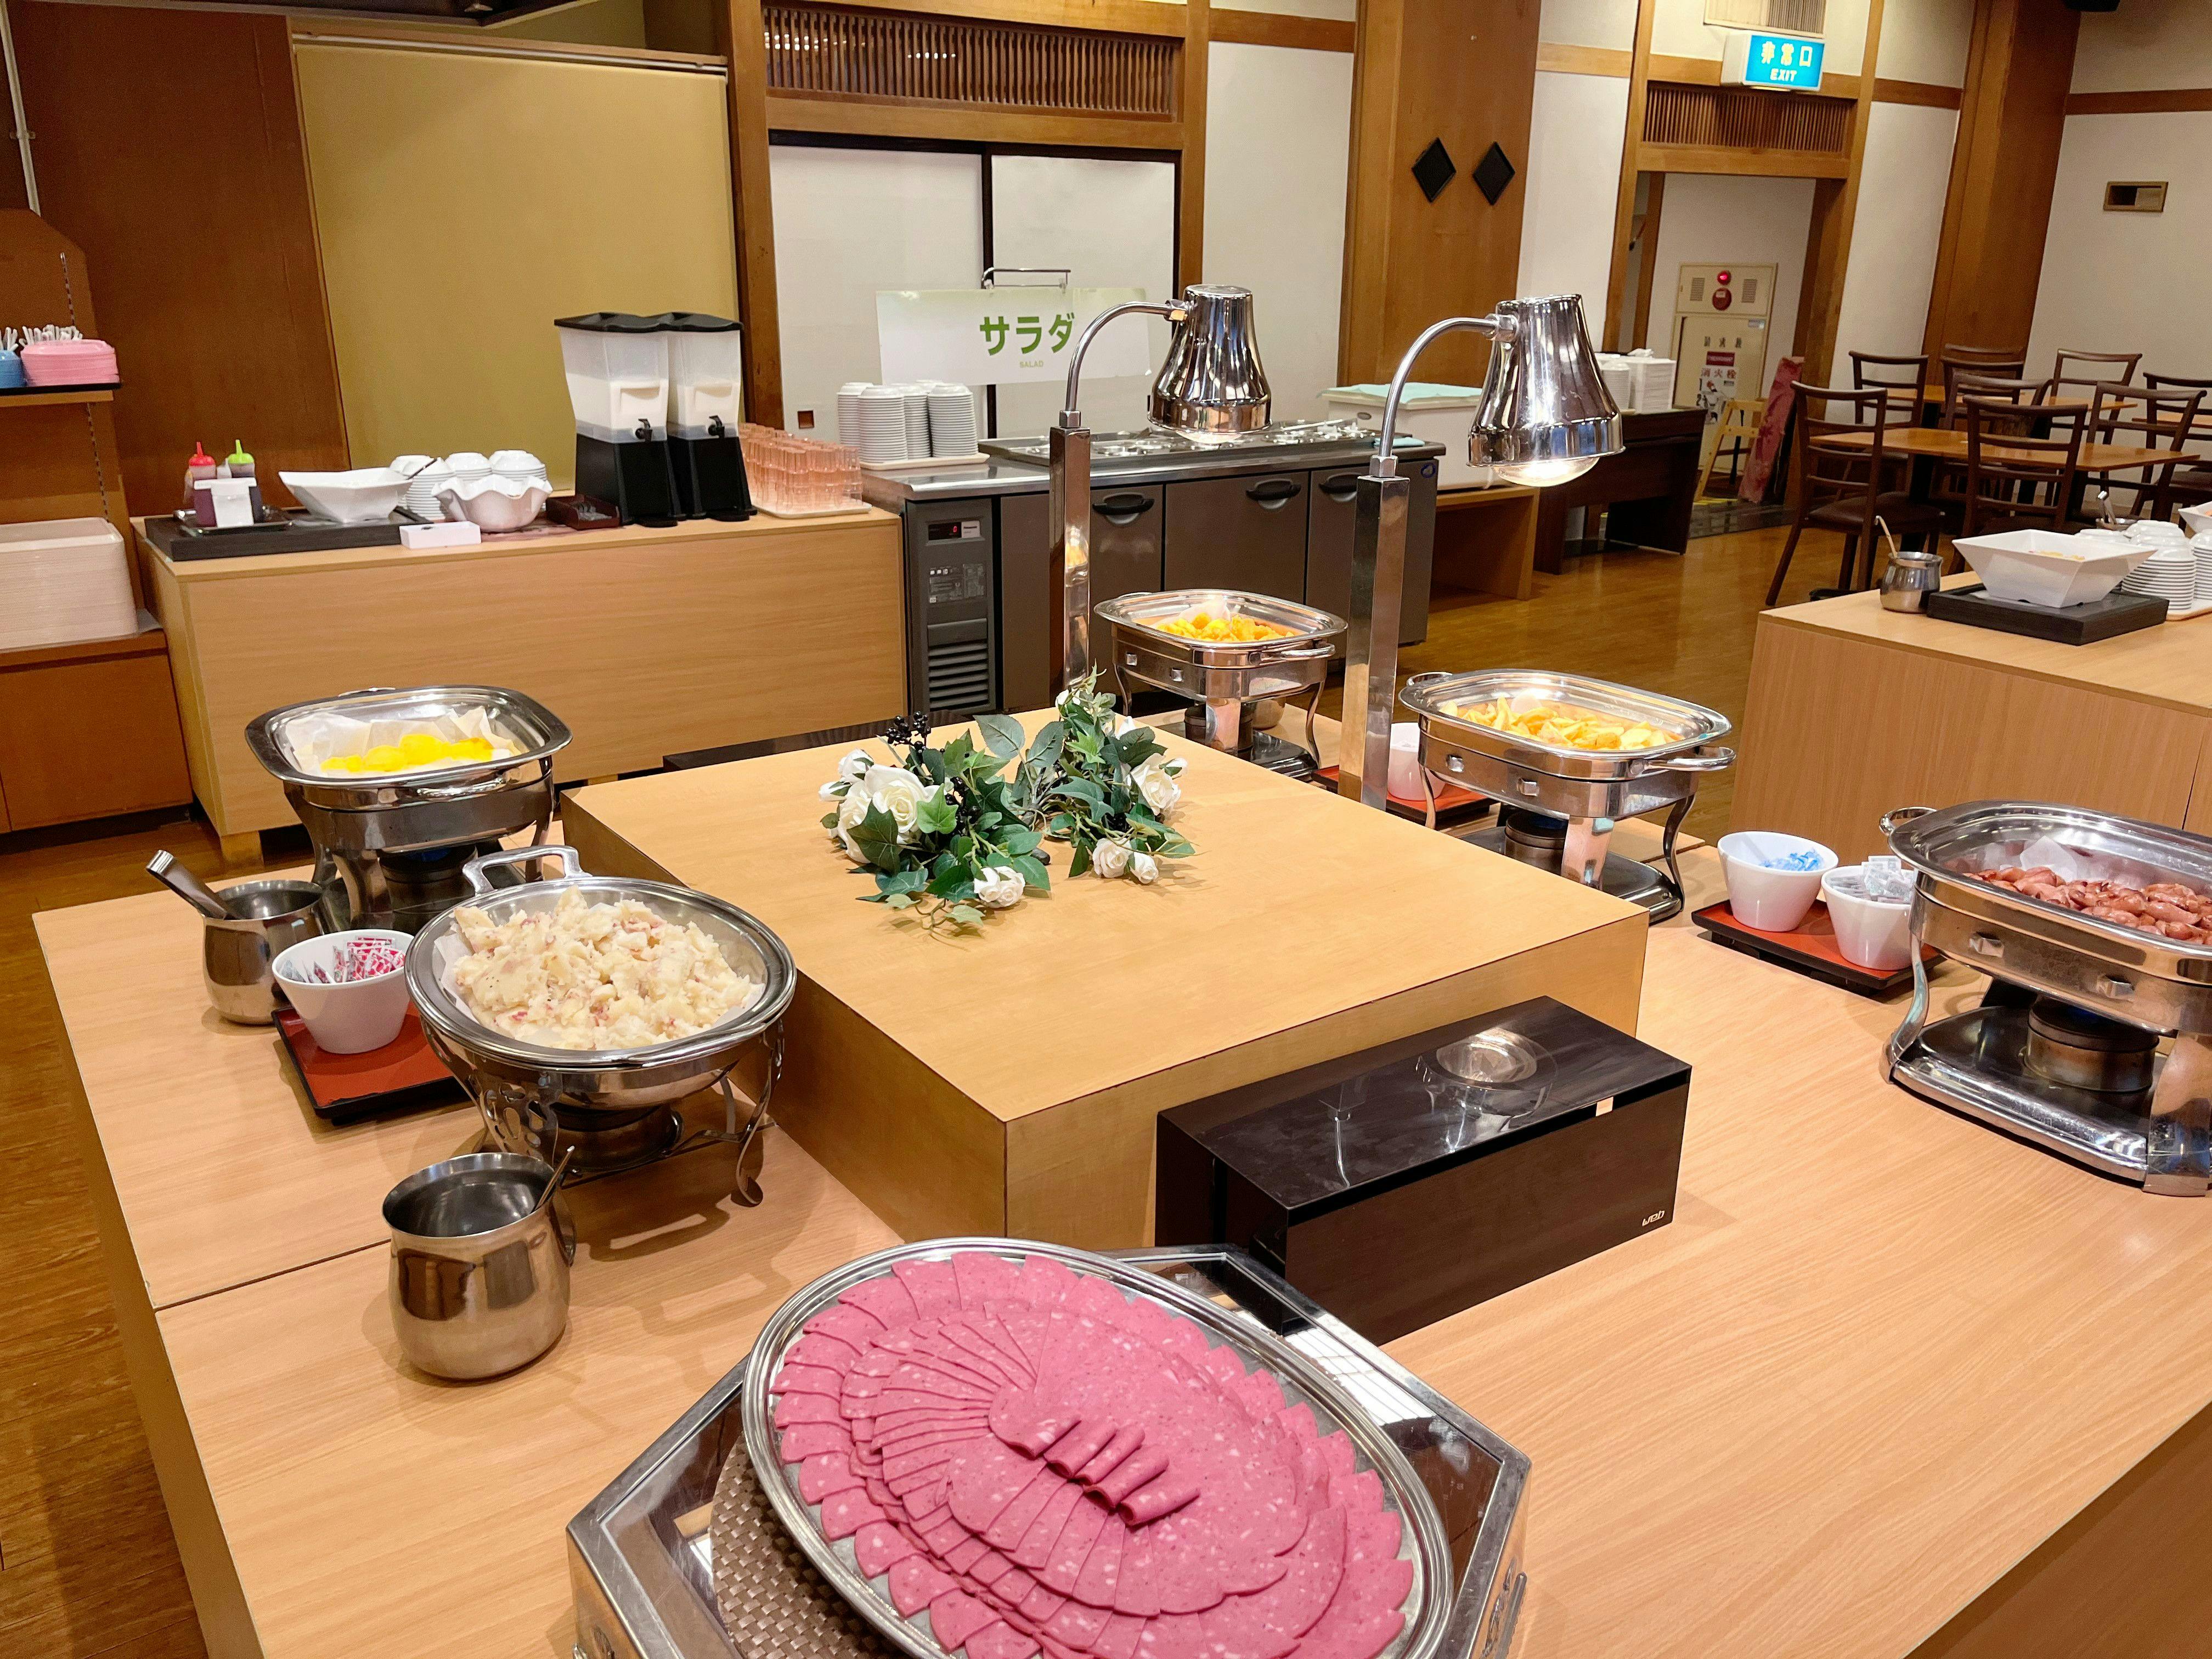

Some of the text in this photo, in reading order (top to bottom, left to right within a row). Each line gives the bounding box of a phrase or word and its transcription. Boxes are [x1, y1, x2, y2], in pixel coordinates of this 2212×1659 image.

[1761, 41, 1813, 67] 非常口
[1770, 68, 1797, 82] EXIT
[980, 312, 1074, 356] サラダ
[1019, 360, 1044, 369] SALAD
